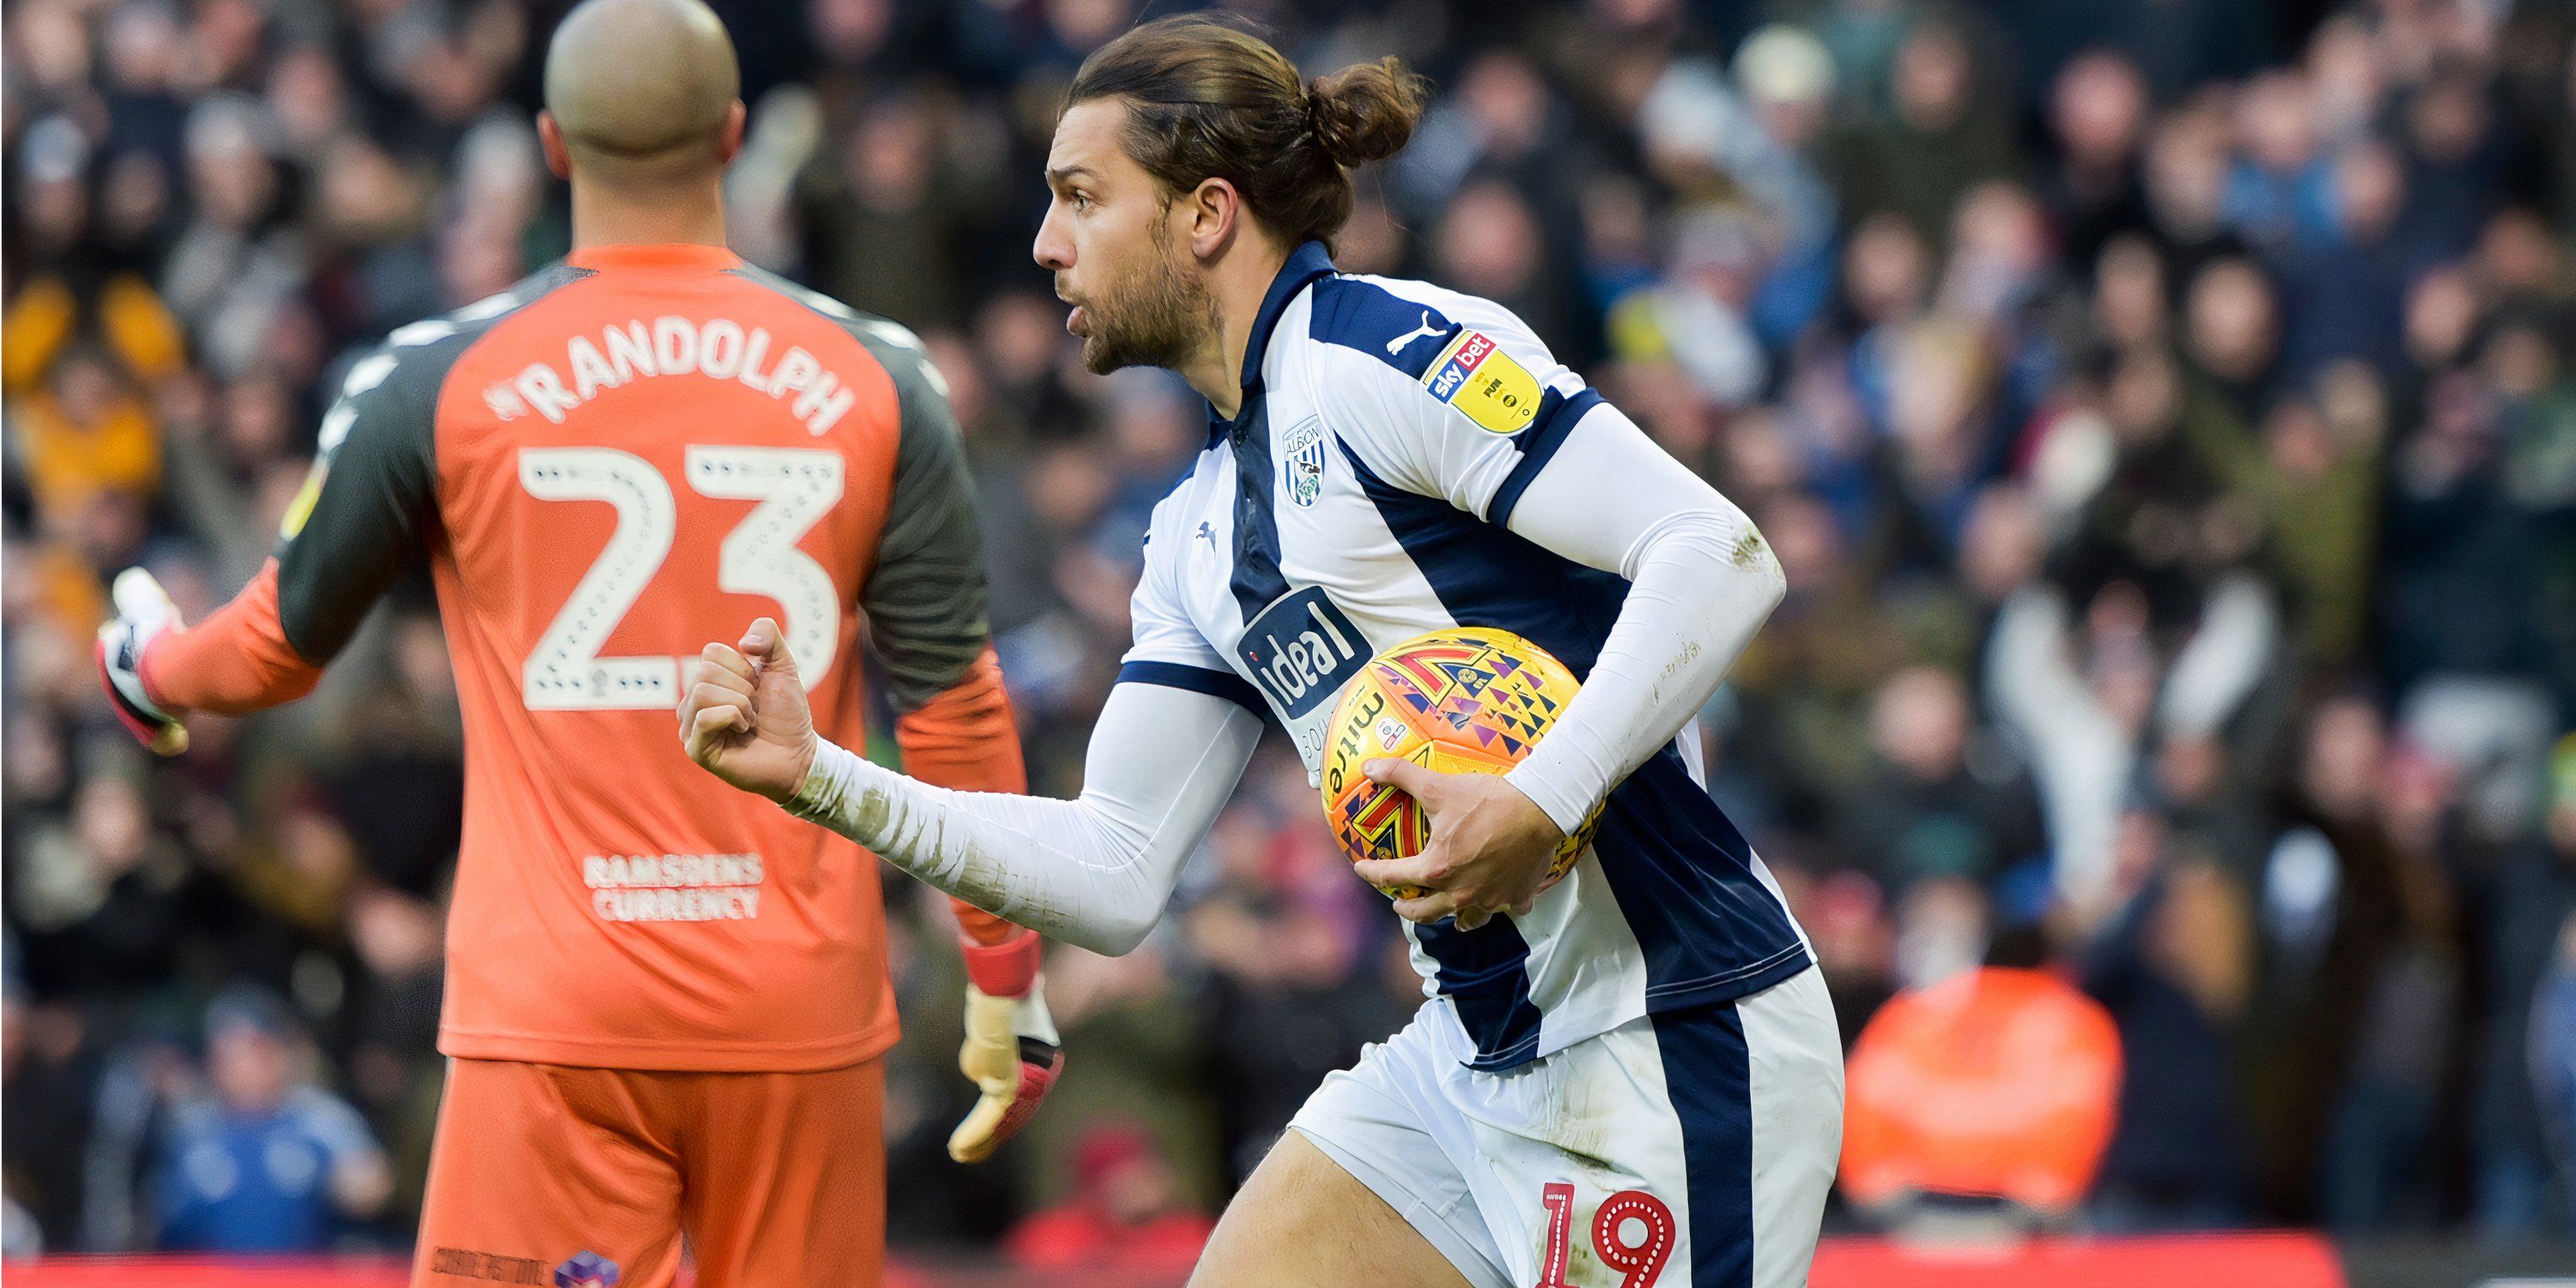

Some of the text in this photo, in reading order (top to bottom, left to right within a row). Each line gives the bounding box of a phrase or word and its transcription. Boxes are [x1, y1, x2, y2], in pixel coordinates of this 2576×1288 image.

[514, 315, 856, 436] RANDOLPH
[1434, 362, 1465, 398] sky
[1455, 337, 1491, 368] bet
[518, 443, 846, 711] 23
[1249, 600, 1356, 706] ideal
[1329, 690, 1385, 795] mitre
[583, 853, 763, 889] RAMSDENS
[592, 886, 760, 922] CURRENCY
[1534, 1182, 1676, 1288] 19
